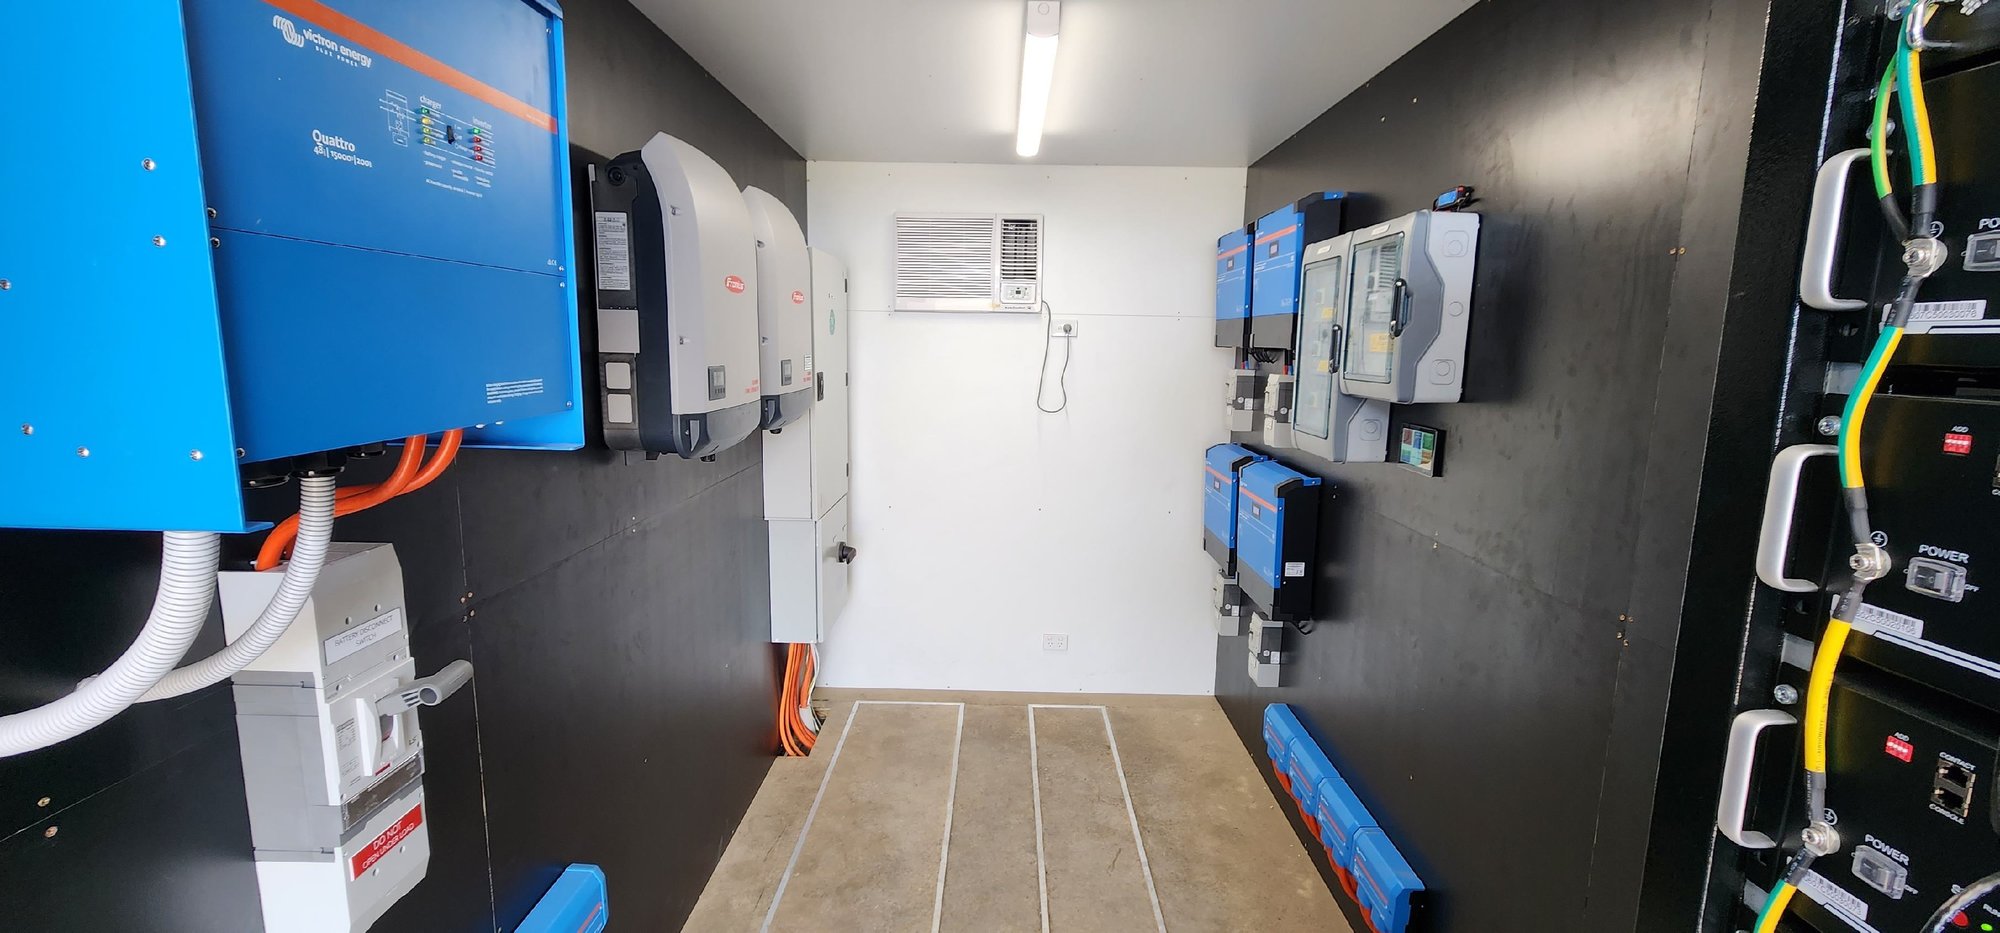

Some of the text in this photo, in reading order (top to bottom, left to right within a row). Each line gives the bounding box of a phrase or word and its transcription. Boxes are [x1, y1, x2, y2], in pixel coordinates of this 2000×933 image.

[303, 28, 372, 68] victron energy
[312, 129, 356, 152] Quattro
[1918, 544, 1969, 564] POWER
[334, 615, 393, 647] BATTERY DISCONNECT
[355, 633, 377, 646] SWITCH
[1938, 751, 1976, 771] CONTACT
[1928, 803, 1965, 825] CONSOLE
[362, 823, 415, 869] OPEN UNDER LOAD
[373, 820, 403, 850] DO NOT
[1864, 833, 1911, 866] POWER
